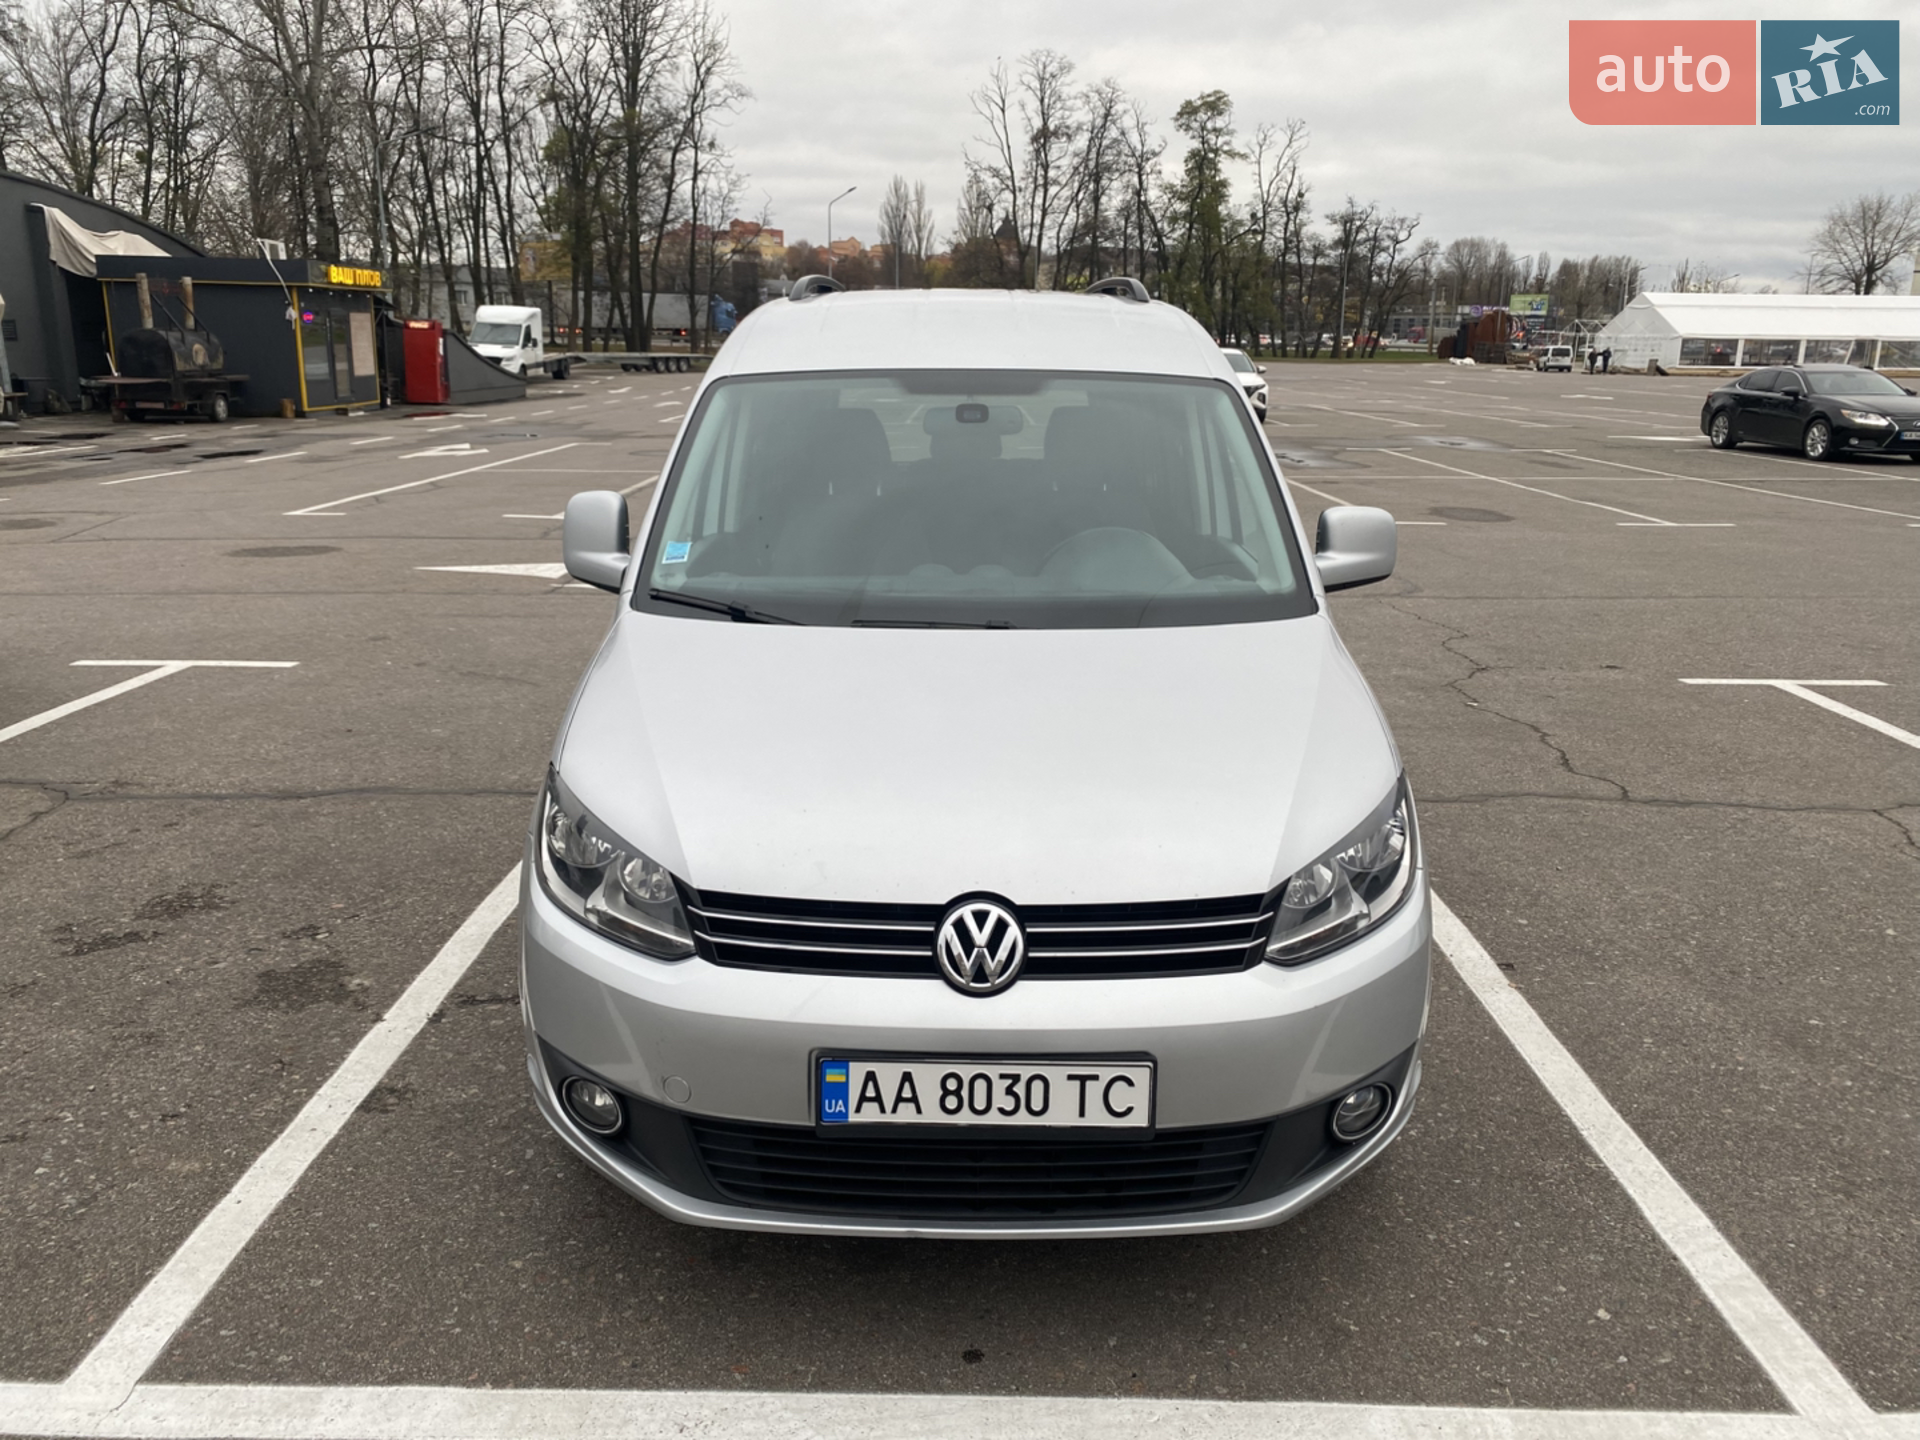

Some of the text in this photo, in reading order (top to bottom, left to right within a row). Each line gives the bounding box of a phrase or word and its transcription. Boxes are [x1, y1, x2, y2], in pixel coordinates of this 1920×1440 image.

[330, 265, 382, 287] ВАШ ПЛОВ
[854, 1070, 1136, 1118] AA 8030 TC
[825, 1099, 846, 1113] UA
